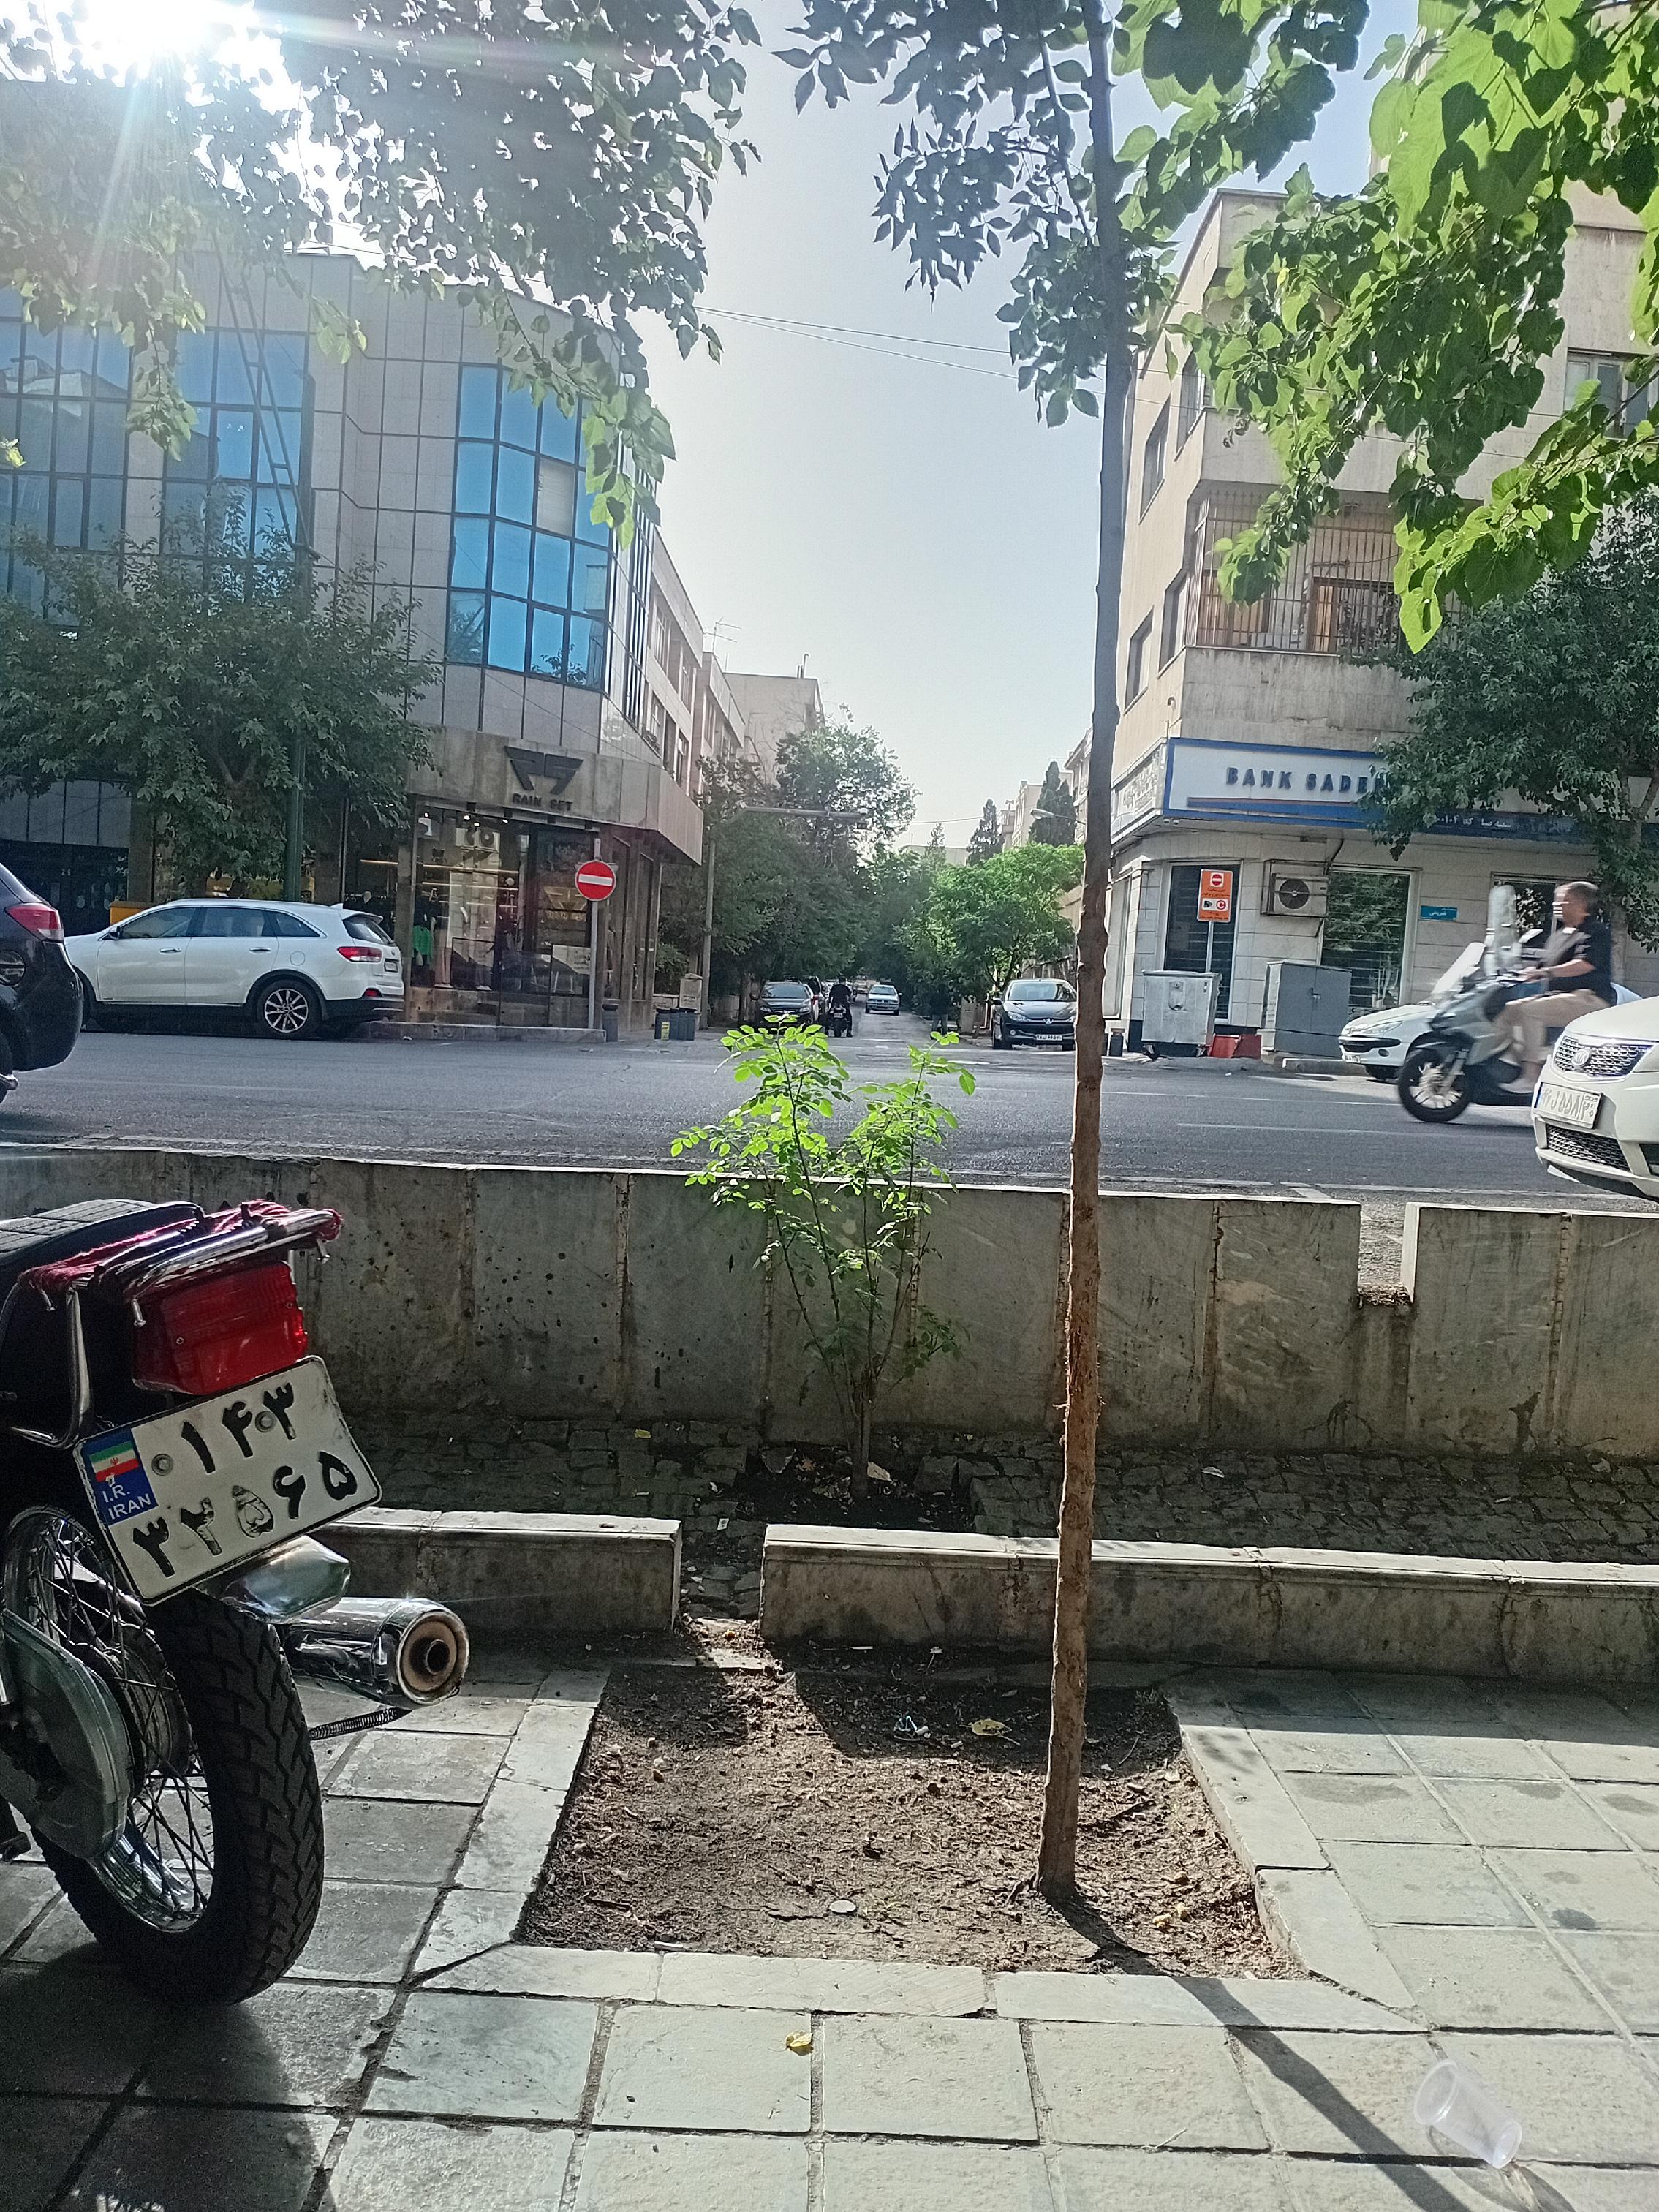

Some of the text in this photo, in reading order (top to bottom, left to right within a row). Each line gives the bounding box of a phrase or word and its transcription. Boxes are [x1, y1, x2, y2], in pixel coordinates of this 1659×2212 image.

[1226, 766, 1292, 790] BANK
[513, 793, 543, 807] RAIN
[181, 1382, 296, 1473] ۱۴۳
[102, 1484, 130, 1503] I.R.
[107, 1493, 151, 1520] IRAN
[132, 1451, 358, 1578] ۳۲۵۶۵
